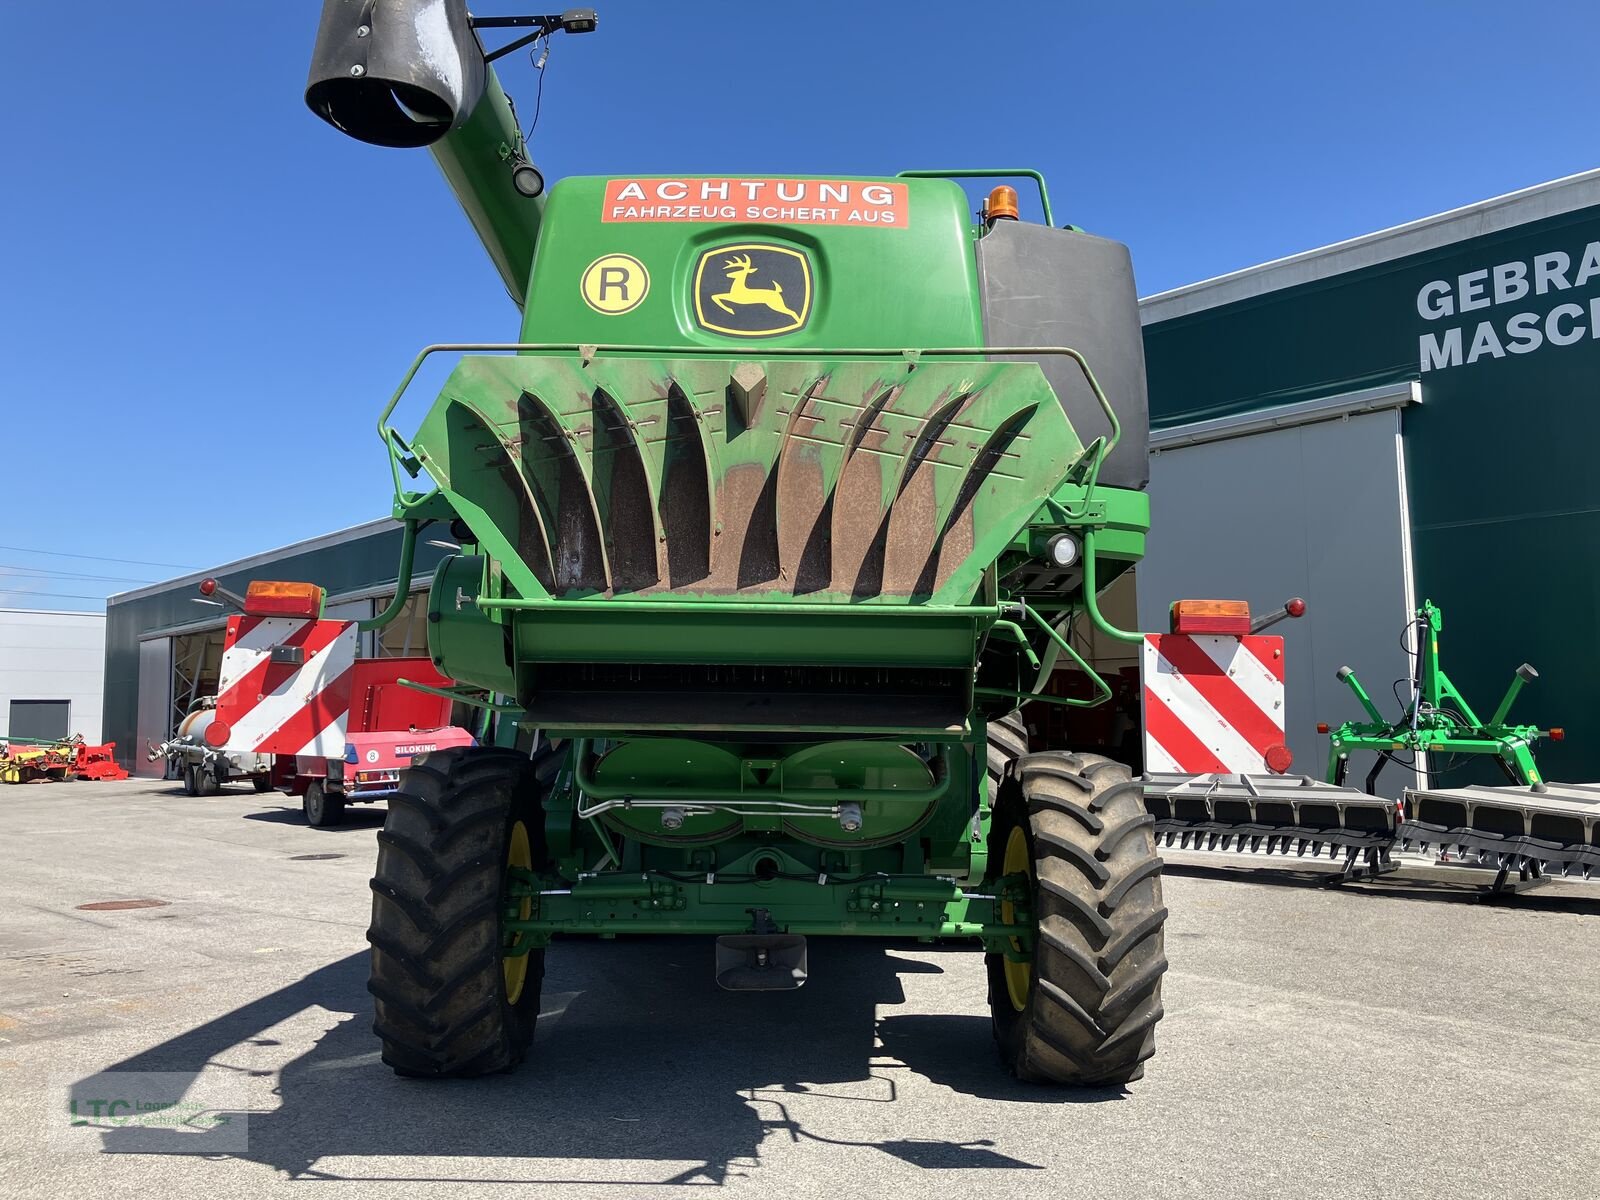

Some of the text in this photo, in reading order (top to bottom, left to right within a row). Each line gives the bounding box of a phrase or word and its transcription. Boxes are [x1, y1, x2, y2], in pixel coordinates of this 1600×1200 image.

[616, 181, 895, 206] ACHTUNG
[612, 205, 896, 224] FAHRZEUG SCHERT AUS
[599, 266, 630, 302] R
[1416, 241, 1600, 320] GEBRA
[1419, 297, 1600, 373] MASC
[395, 744, 437, 754] SILOKING
